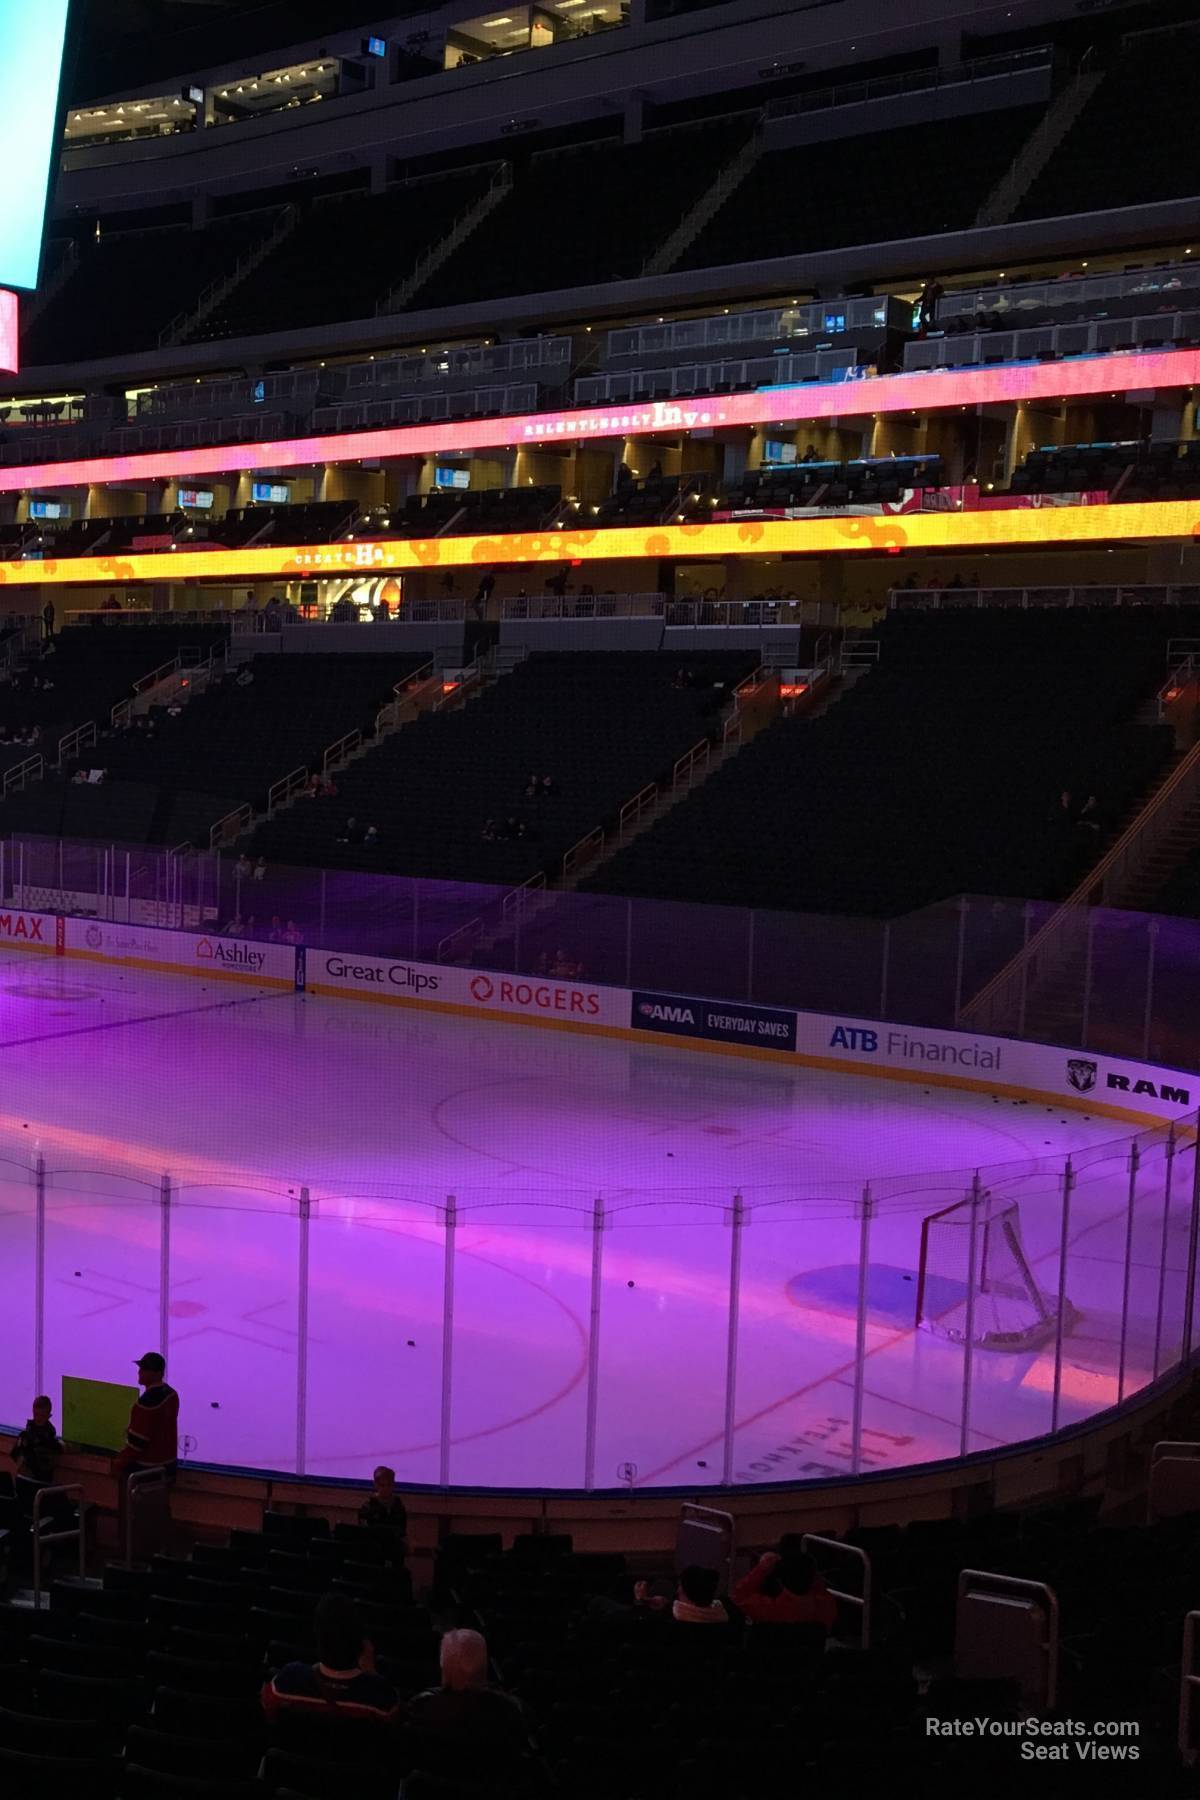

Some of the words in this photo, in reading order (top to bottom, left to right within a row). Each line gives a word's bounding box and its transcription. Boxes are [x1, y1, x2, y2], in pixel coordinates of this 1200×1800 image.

[523, 413, 652, 436] RELENTLESSLY
[295, 552, 353, 565] CREATE
[214, 942, 266, 971] Ashley
[326, 957, 385, 983] Great
[388, 965, 439, 993] Clips
[500, 981, 601, 1015] ROGERS
[650, 1004, 696, 1025] AMA
[707, 1014, 760, 1034] EVERYDAY
[759, 1021, 790, 1038] SAVES
[830, 1025, 878, 1052] ATB
[887, 1032, 1002, 1070] Financial
[1106, 1072, 1191, 1106] RAM
